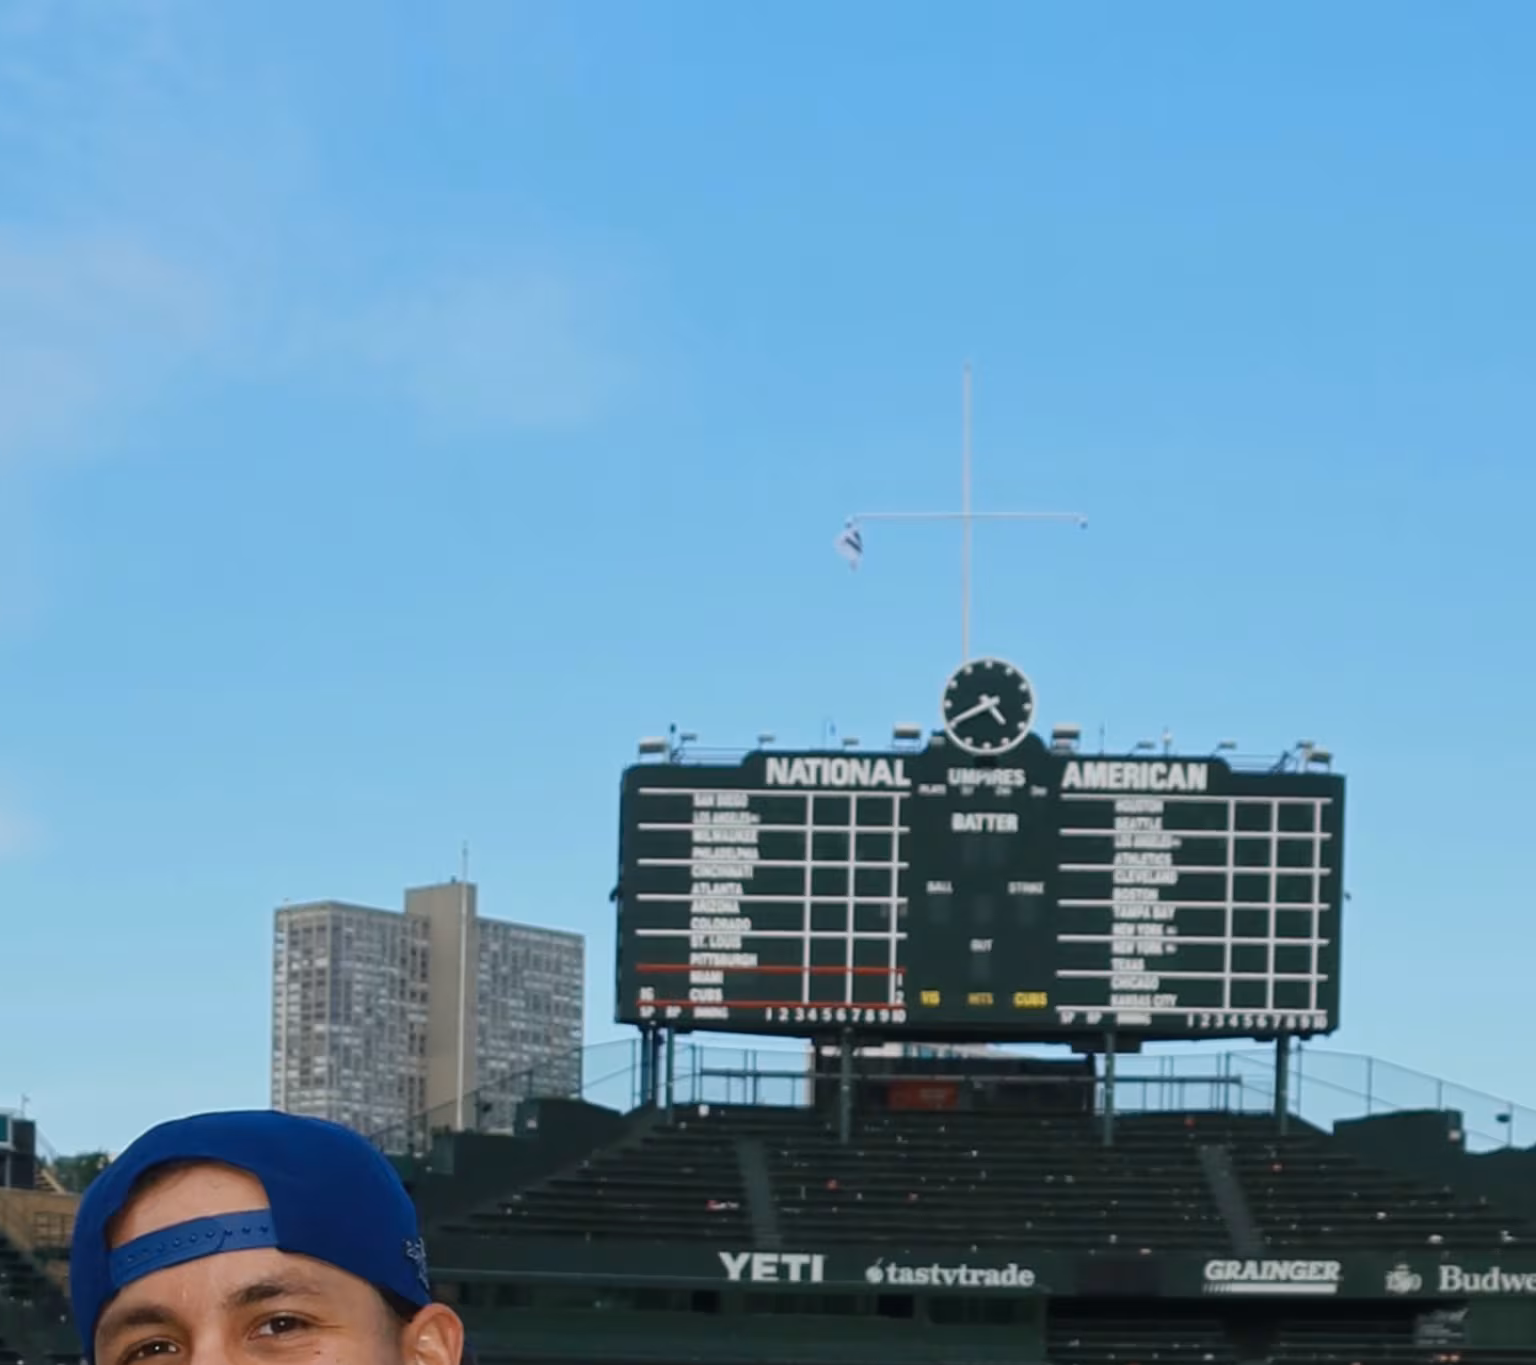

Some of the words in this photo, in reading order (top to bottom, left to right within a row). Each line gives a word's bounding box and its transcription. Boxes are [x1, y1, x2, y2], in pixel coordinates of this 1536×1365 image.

[765, 757, 911, 786] NATIONAL
[947, 768, 1025, 786] UMPIRES
[1061, 761, 1207, 790] AMERICAN
[951, 813, 1019, 832] BATTER
[1013, 992, 1048, 1007] CUBS
[718, 1252, 825, 1283] YETI
[1204, 1260, 1342, 1281] GRAINGER
